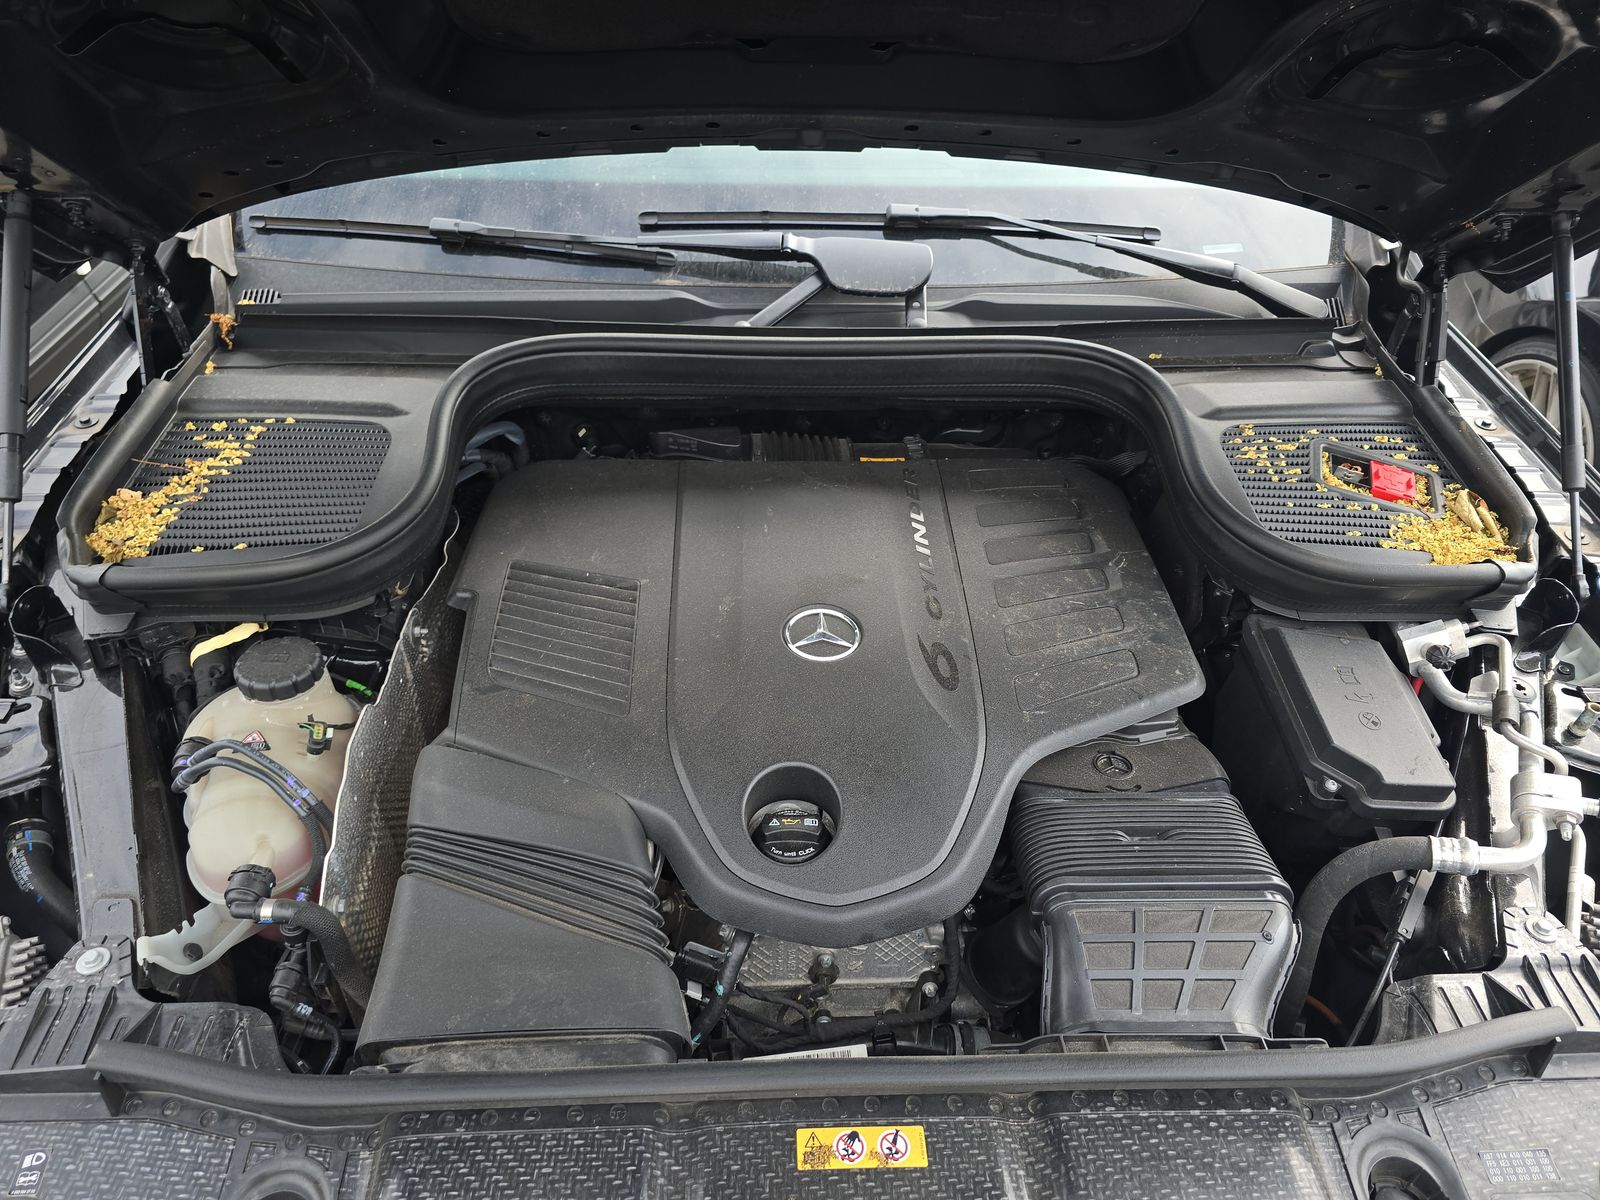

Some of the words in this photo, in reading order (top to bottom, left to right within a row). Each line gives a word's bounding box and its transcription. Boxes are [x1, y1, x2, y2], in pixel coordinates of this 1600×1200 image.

[903, 468, 943, 621] CYLINDER
[917, 632, 959, 692] 6
[769, 846, 783, 856] Turn
[798, 846, 815, 856] CLICK
